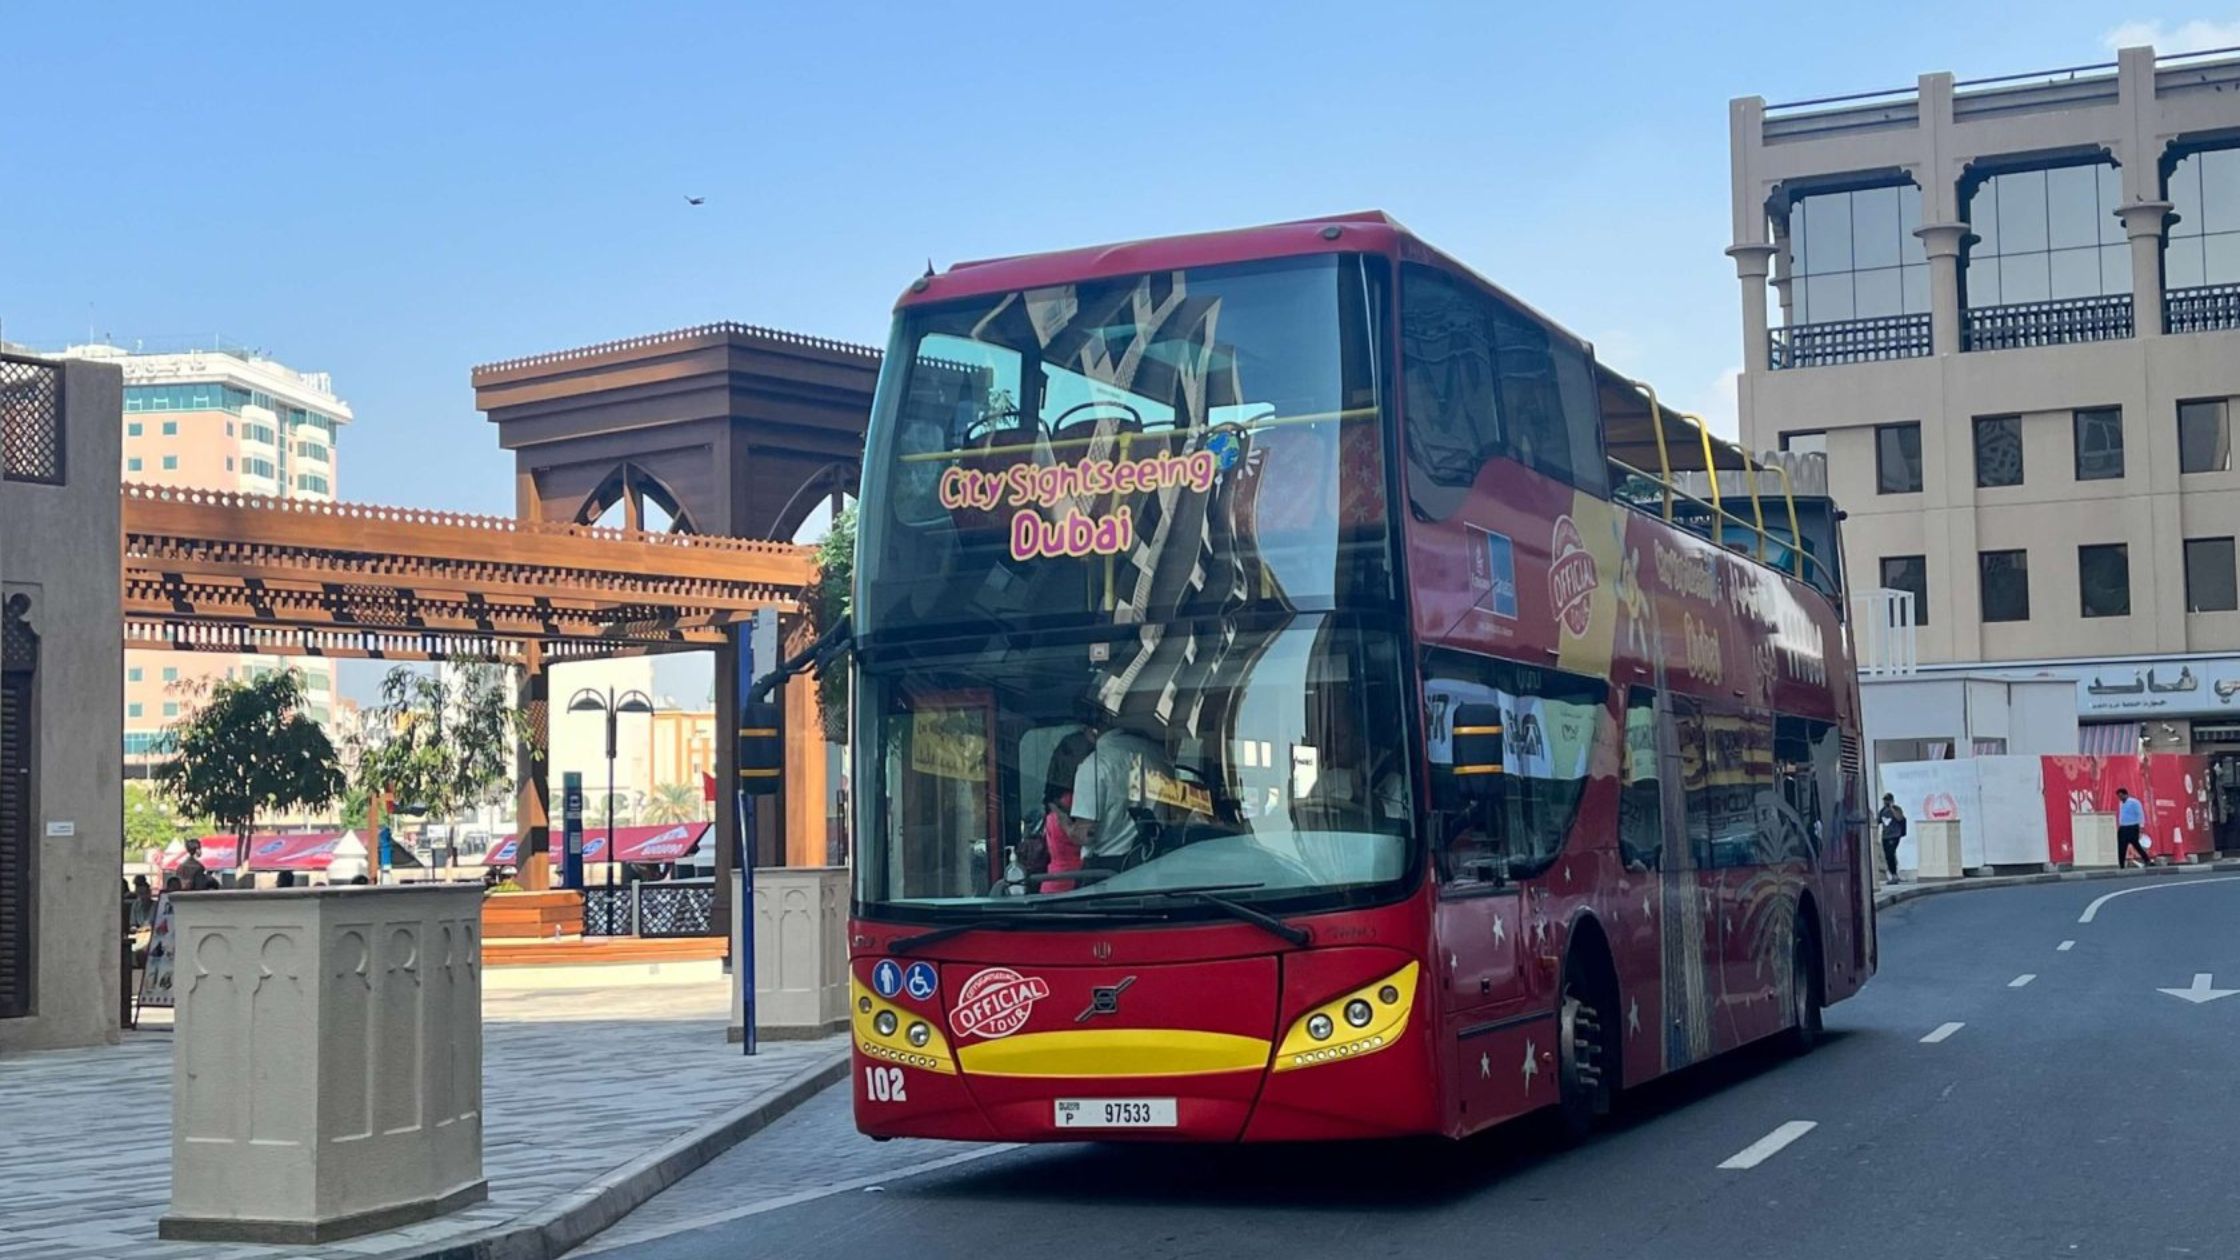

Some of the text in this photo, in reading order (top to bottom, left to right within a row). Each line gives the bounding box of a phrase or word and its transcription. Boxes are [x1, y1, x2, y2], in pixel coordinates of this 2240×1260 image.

[940, 450, 1215, 510] City Sightseeing
[1011, 506, 1132, 561] Dubai
[1554, 558, 1597, 608] OFFICIAL
[960, 981, 1043, 1029] OFFICIAL
[989, 1008, 1027, 1032] TOUR
[865, 1066, 907, 1102] 102
[1066, 1112, 1074, 1125] P
[1105, 1103, 1151, 1123] 97533
